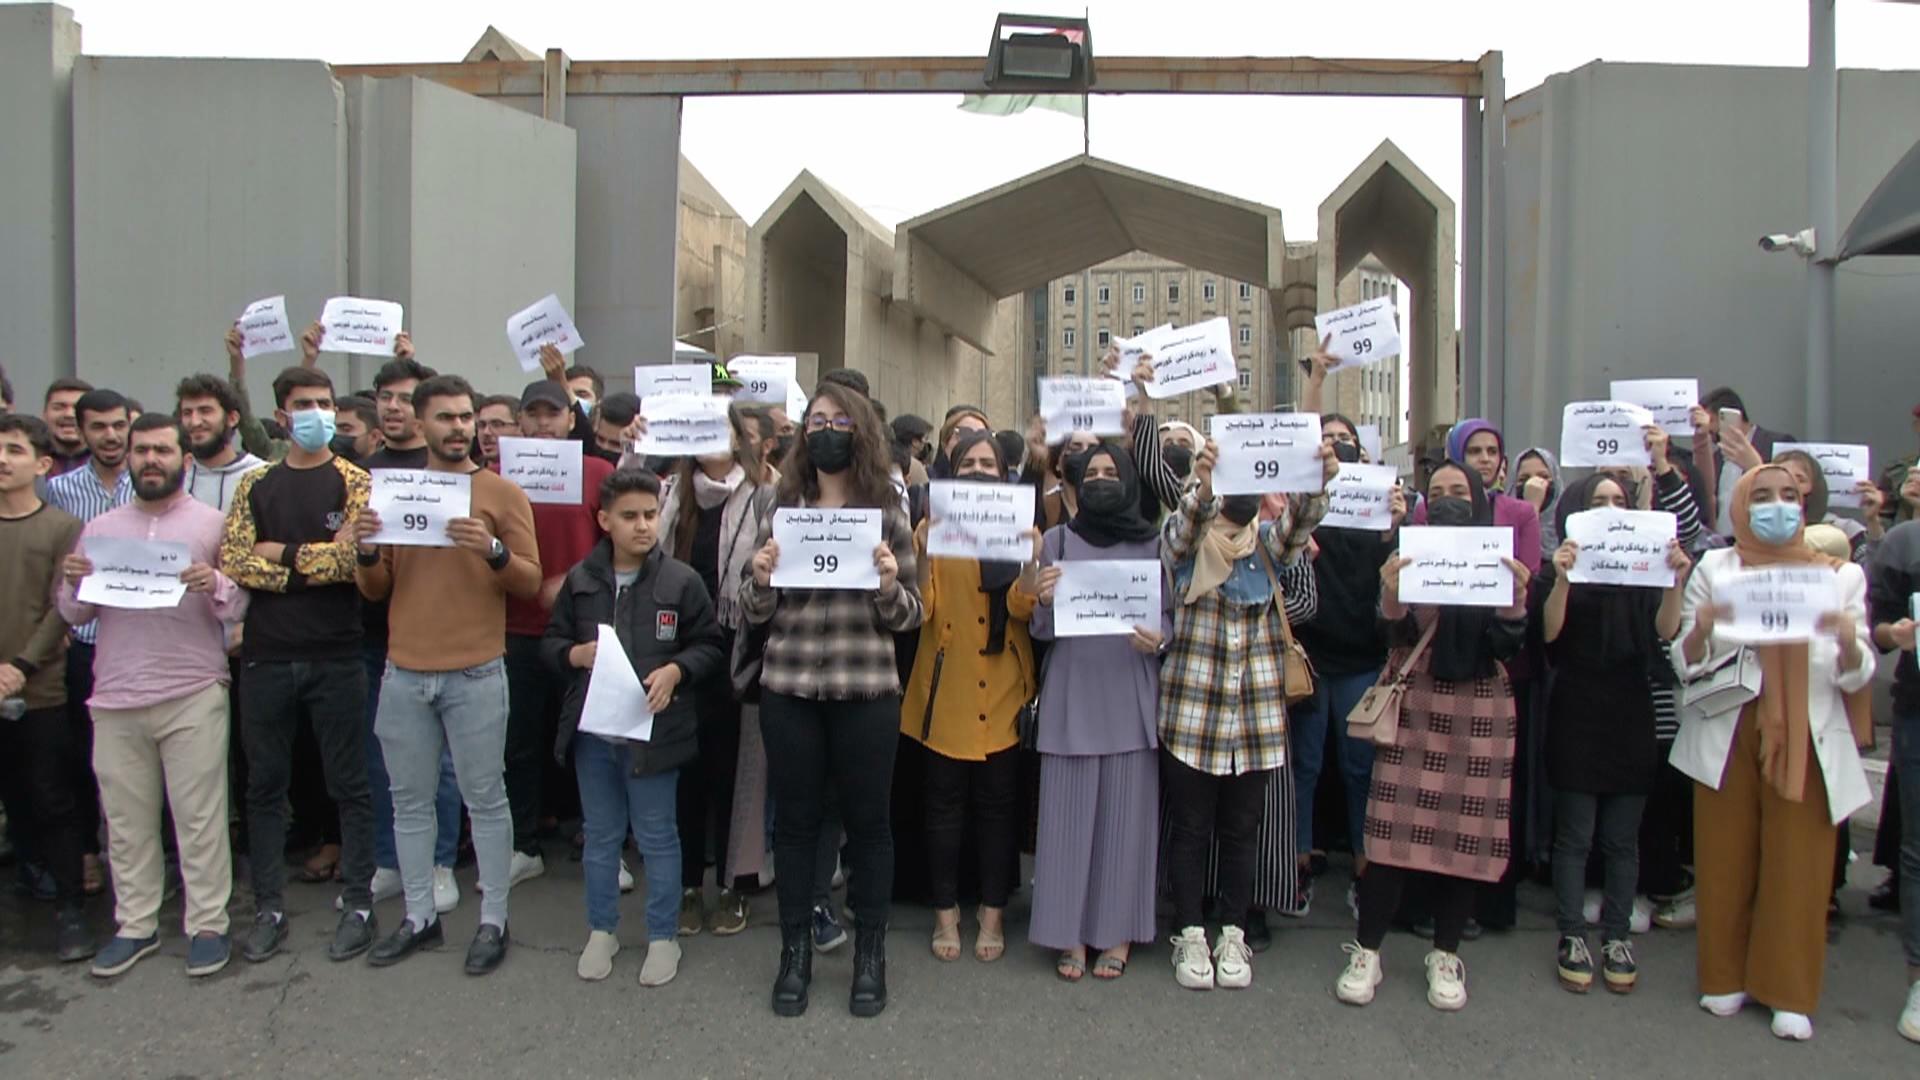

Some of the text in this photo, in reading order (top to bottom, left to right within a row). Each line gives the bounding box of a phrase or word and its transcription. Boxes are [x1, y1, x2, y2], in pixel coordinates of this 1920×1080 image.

[1353, 338, 1372, 355] 99
[751, 380, 768, 393] 99
[1597, 439, 1619, 455] 99
[1254, 460, 1279, 479] 99
[403, 513, 428, 531] 99
[813, 553, 839, 574] 99
